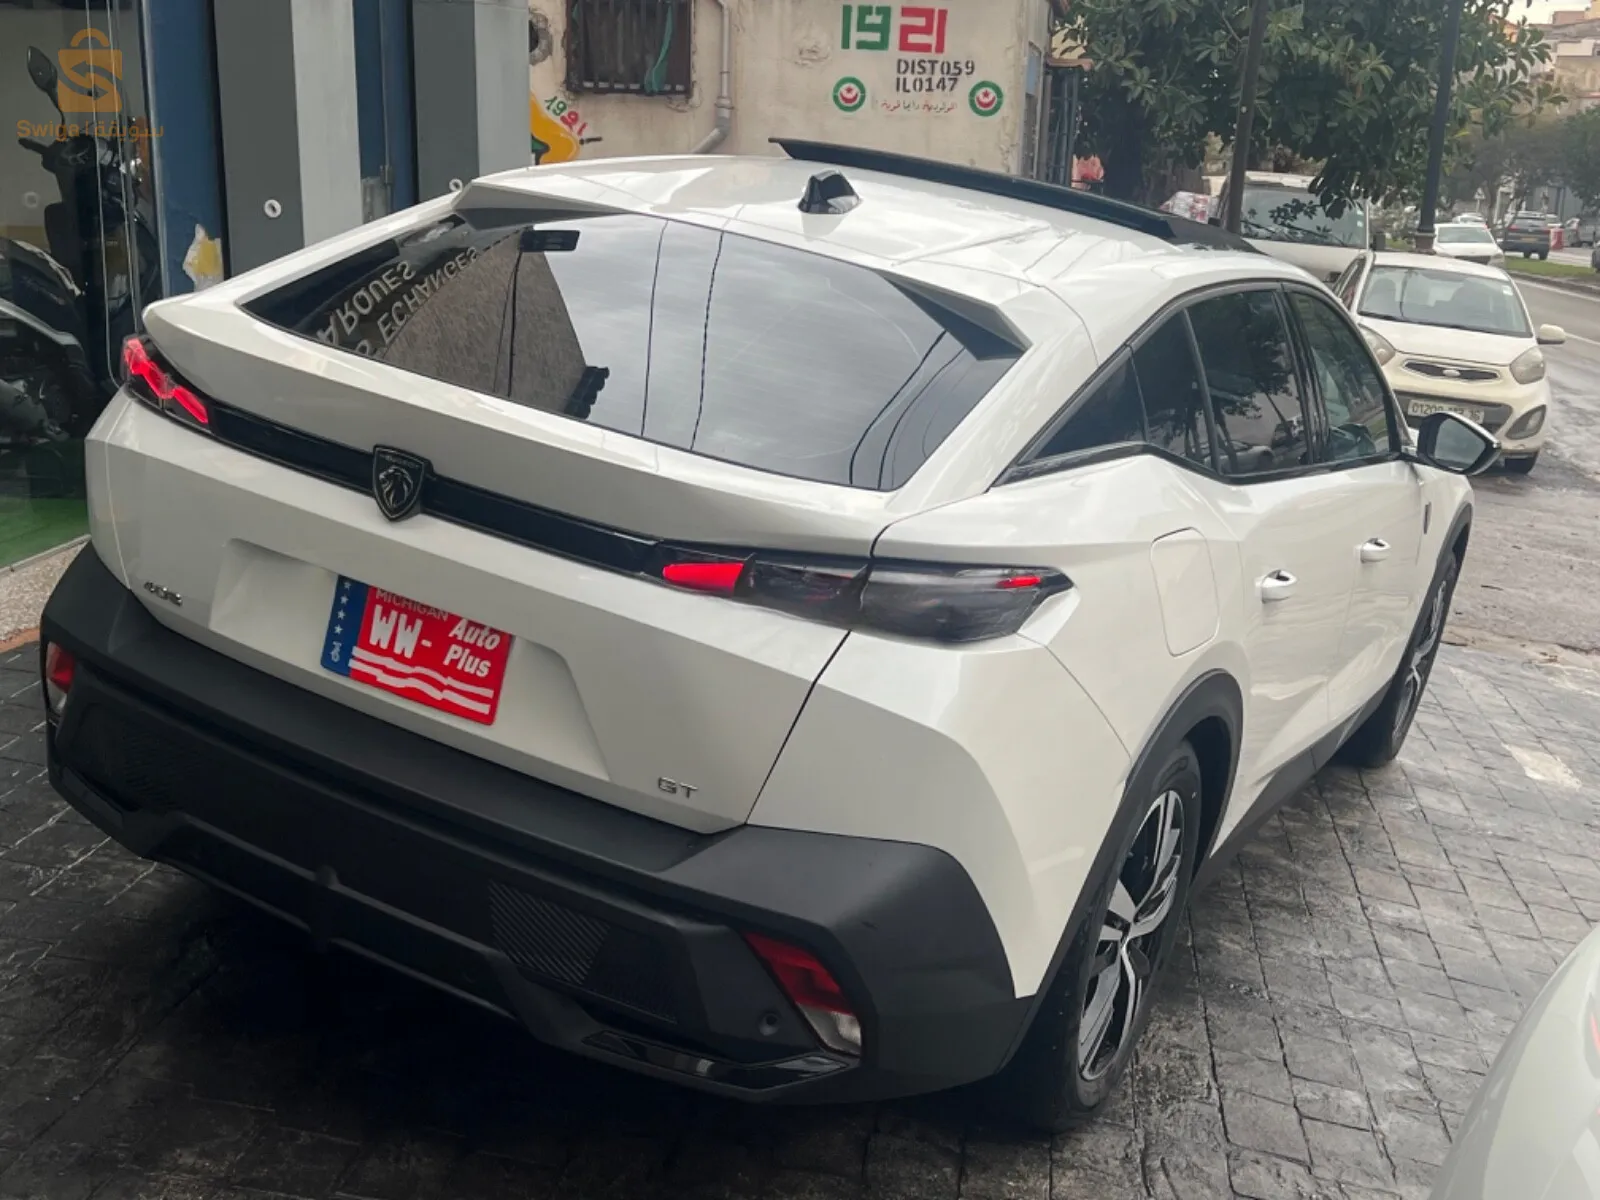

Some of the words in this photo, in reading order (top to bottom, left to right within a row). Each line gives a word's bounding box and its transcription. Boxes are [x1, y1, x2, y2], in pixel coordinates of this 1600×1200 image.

[841, 4, 948, 54] 1921
[448, 618, 501, 651] Auto
[442, 643, 492, 677] Plus
[658, 777, 699, 799] GT
